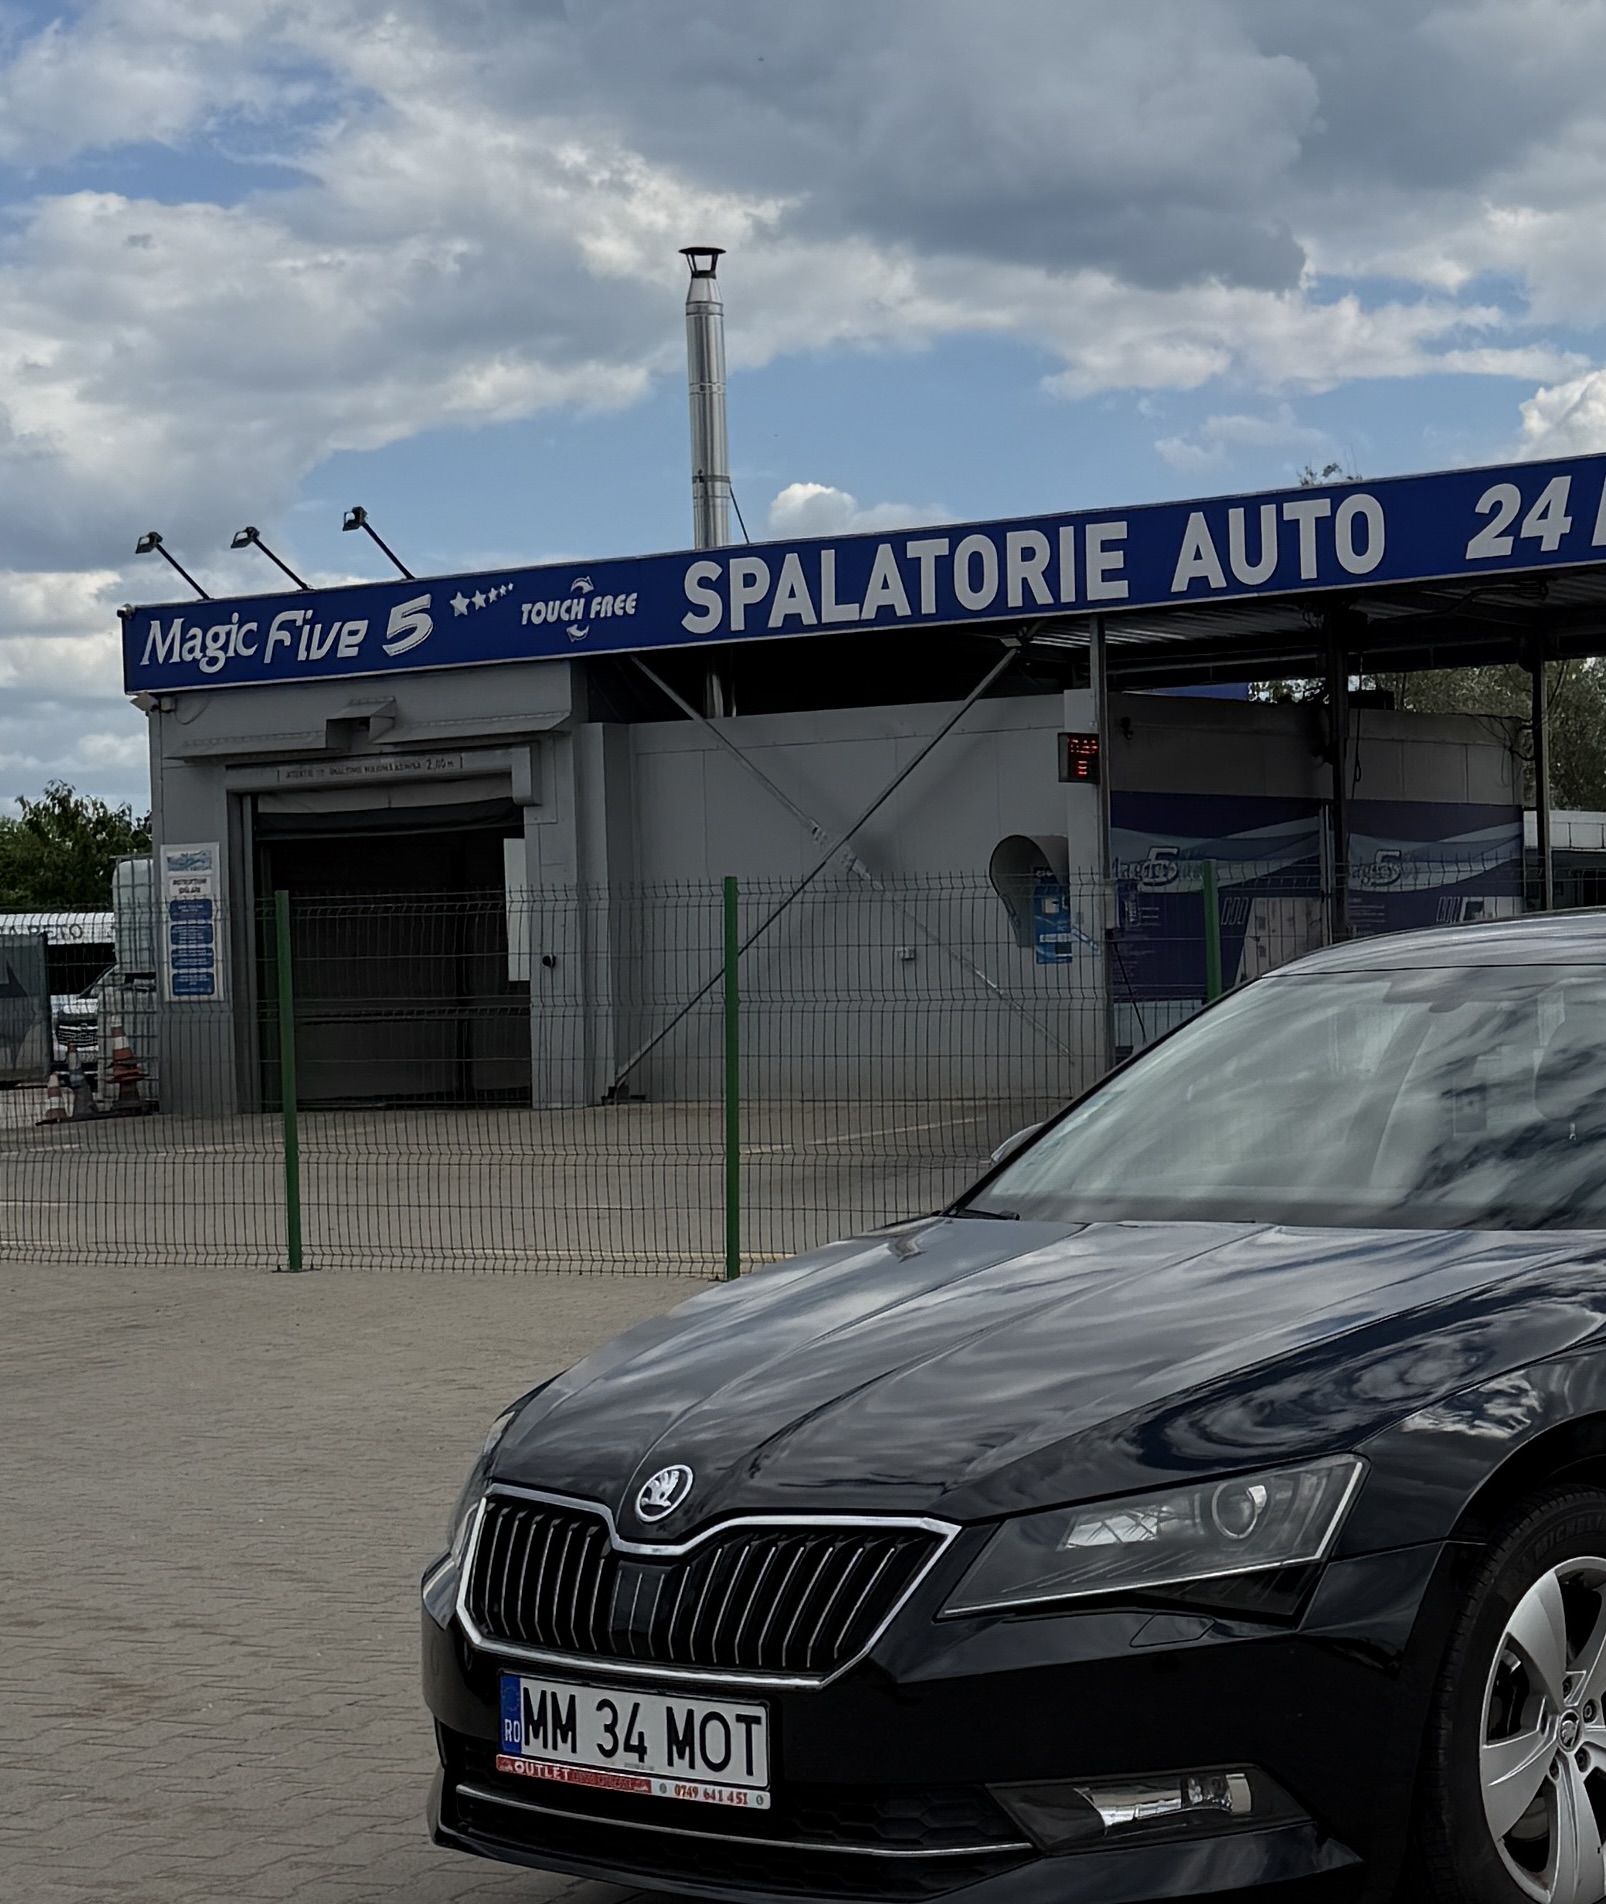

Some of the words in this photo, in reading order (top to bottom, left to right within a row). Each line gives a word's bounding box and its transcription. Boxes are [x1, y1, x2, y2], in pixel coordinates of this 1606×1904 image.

[680, 520, 1129, 634] SPALATORIE
[1170, 493, 1385, 593] AUTO
[1464, 475, 1573, 561] 24
[140, 612, 259, 673] Magic
[263, 609, 369, 664] Five
[382, 593, 434, 657] 5
[521, 598, 586, 625] TOUCH
[589, 592, 638, 619] FREE
[504, 1718, 521, 1743] RO
[522, 1687, 578, 1754] MM
[596, 1698, 648, 1764] 34
[666, 1706, 762, 1777] MOT
[514, 1761, 570, 1781] OUTLET
